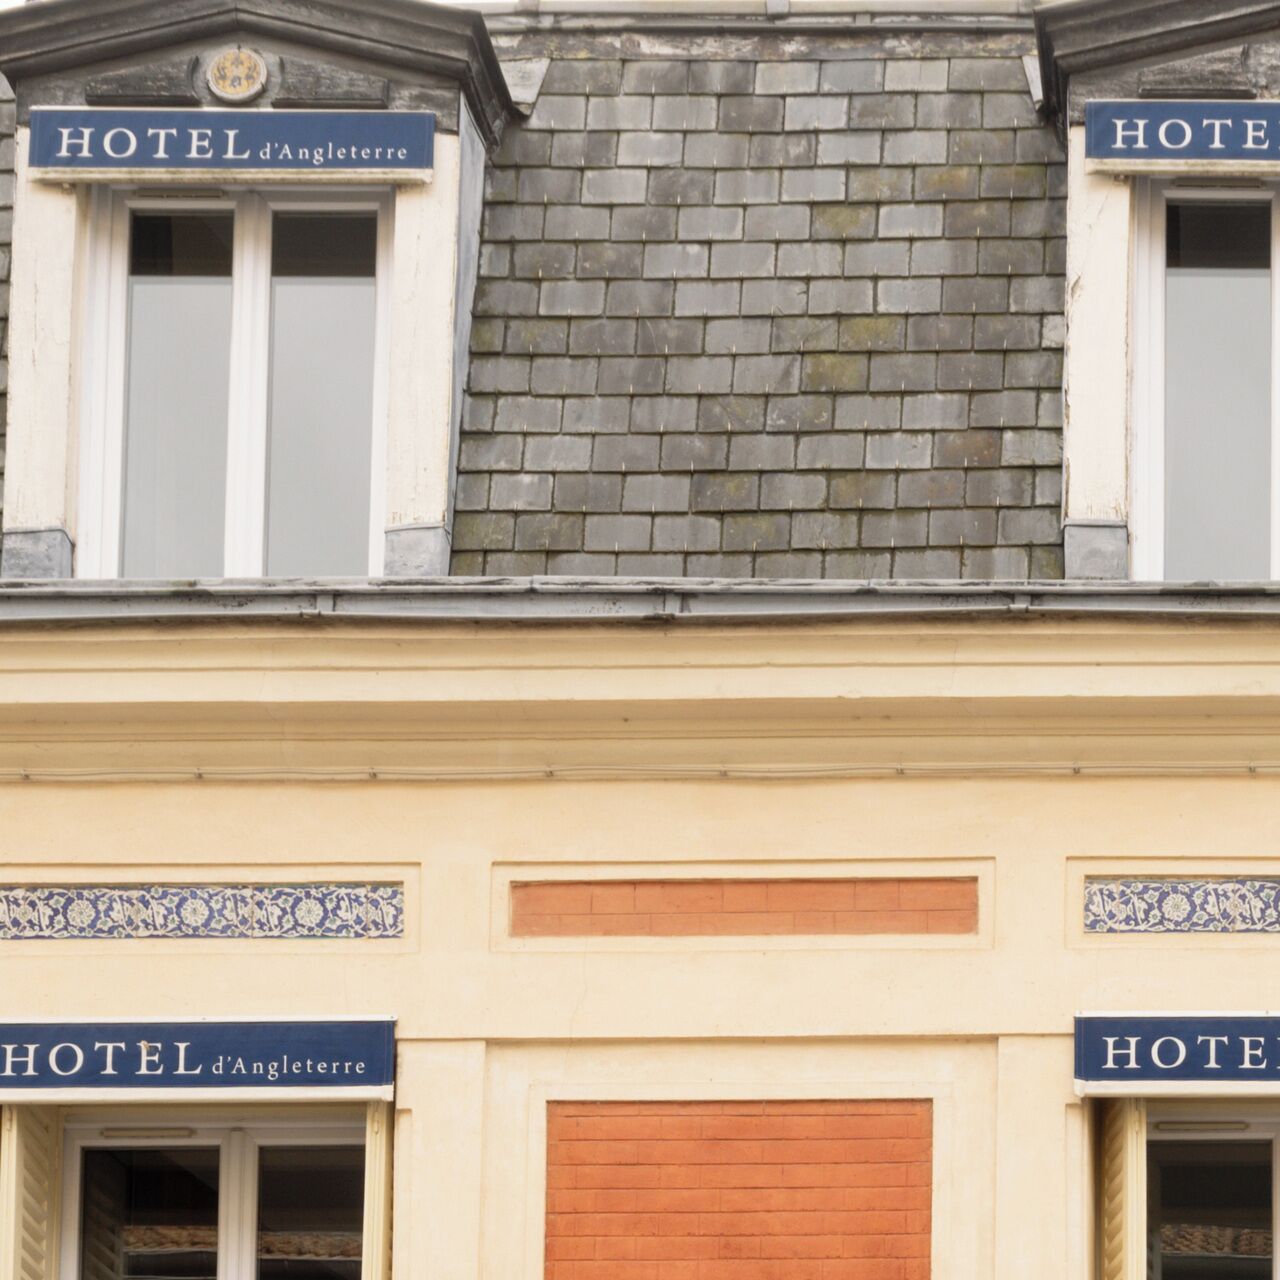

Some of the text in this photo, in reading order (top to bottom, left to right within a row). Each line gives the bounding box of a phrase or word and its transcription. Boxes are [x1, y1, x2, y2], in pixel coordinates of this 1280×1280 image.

[56, 127, 407, 165] HOTEL d'Angleterre
[0, 1042, 365, 1081] HOTEL d'Angleterre
